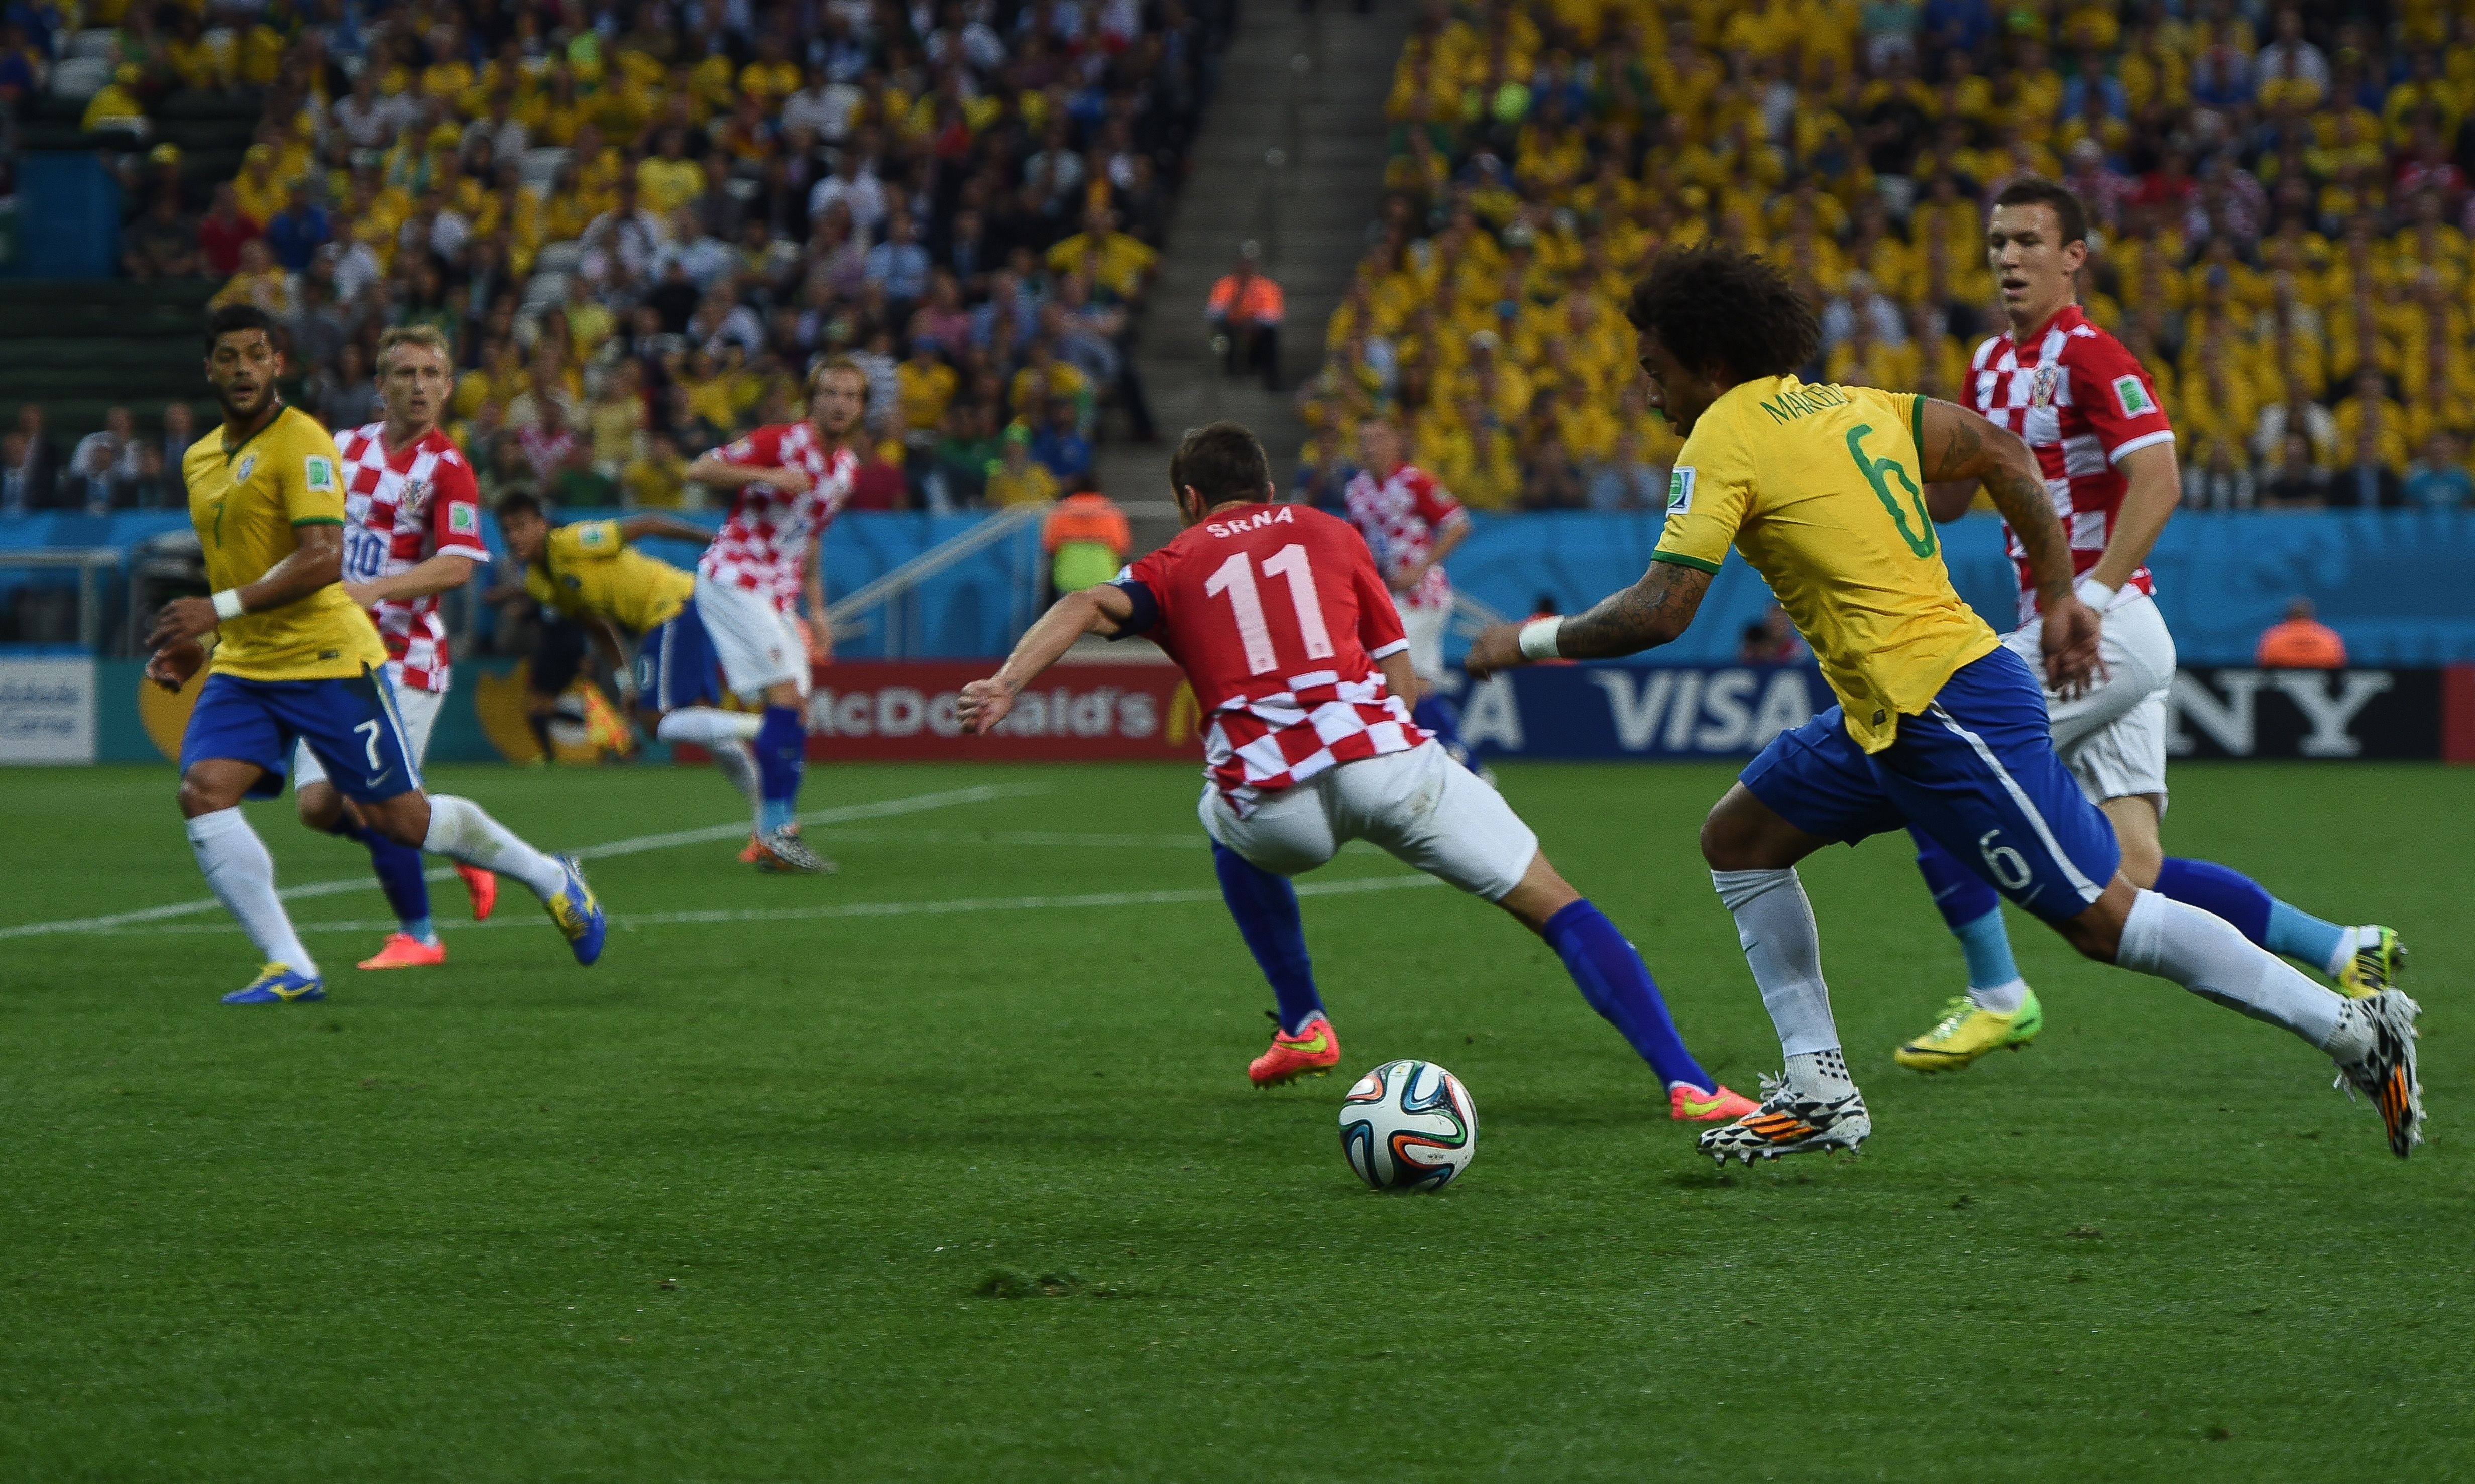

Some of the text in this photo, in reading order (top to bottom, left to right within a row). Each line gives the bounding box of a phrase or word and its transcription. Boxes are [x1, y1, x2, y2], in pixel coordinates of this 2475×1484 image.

[1846, 423, 1936, 559] 6
[209, 502, 224, 548] 7
[1206, 505, 1294, 538] SRNA
[348, 533, 384, 577] 10
[1205, 543, 1335, 676] 11
[807, 685, 1158, 738] McDoald's
[1587, 667, 1812, 753] VISA
[2167, 668, 2394, 757] NY
[354, 719, 380, 770] 7
[1979, 829, 2032, 889] 6
